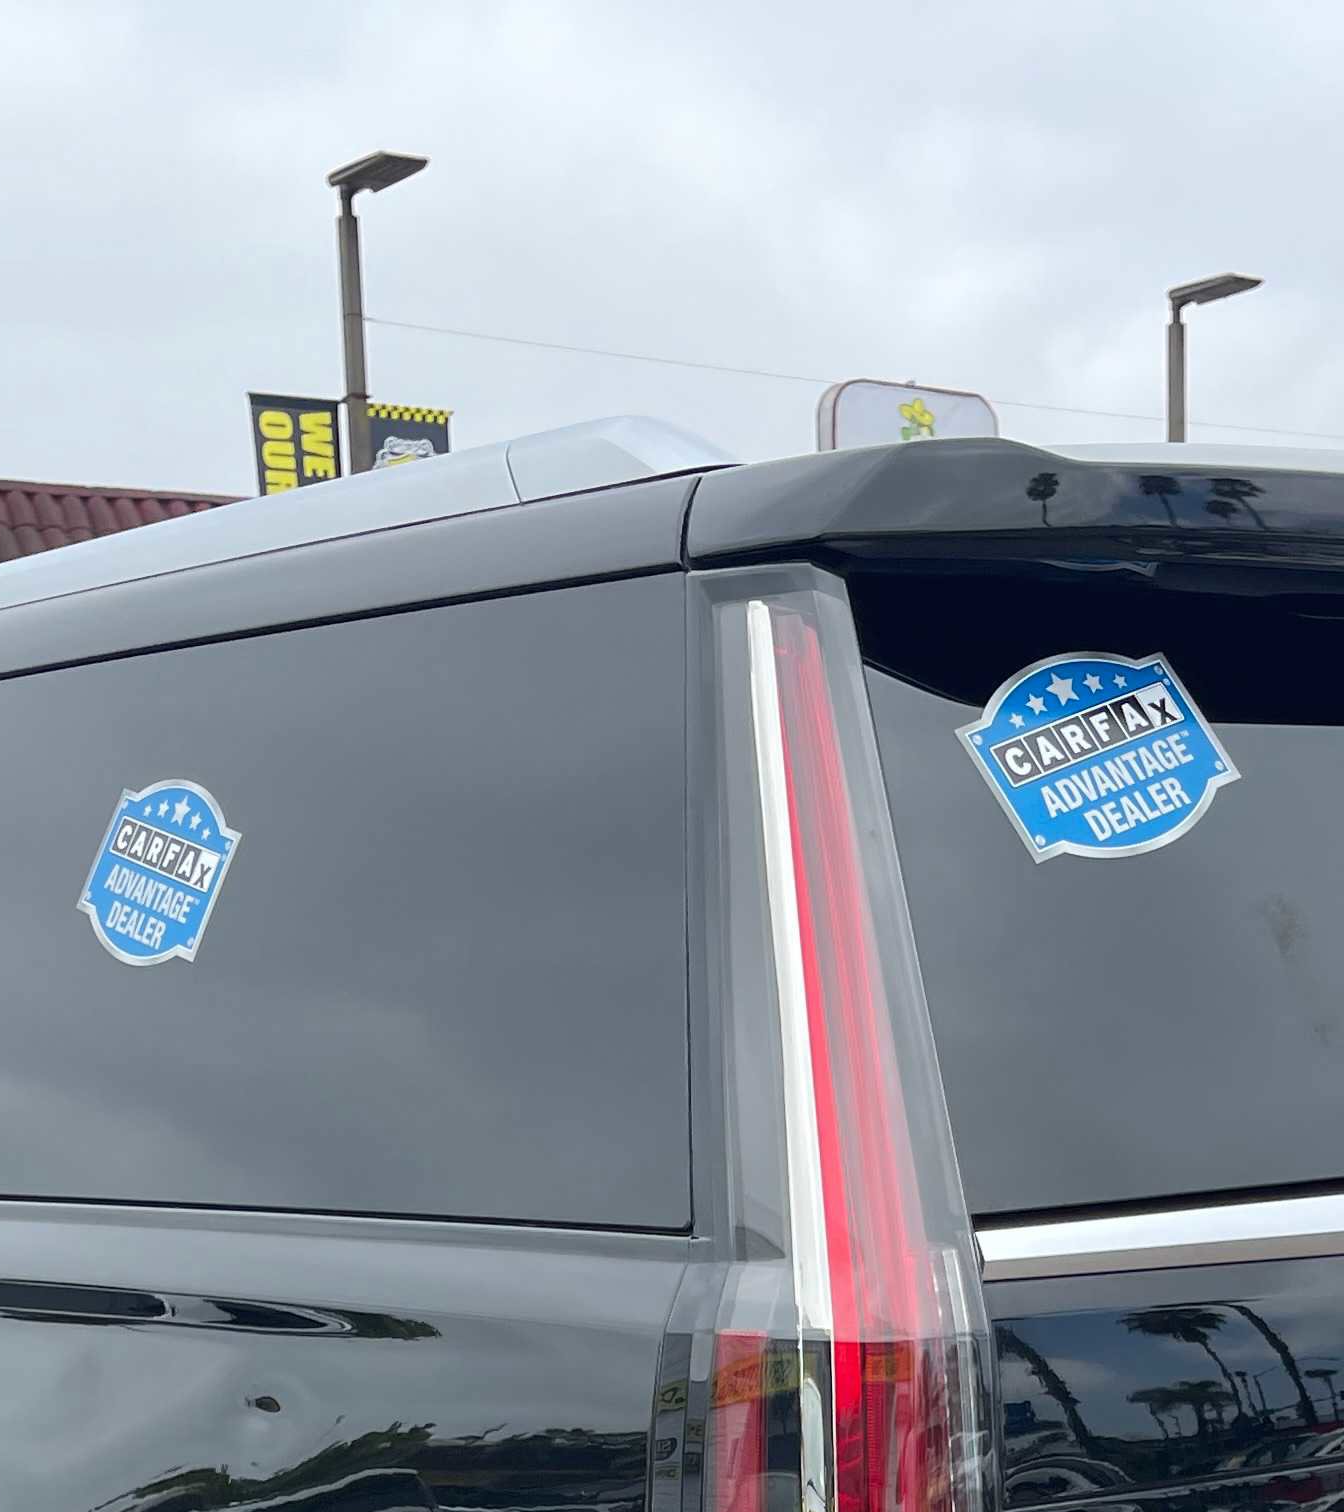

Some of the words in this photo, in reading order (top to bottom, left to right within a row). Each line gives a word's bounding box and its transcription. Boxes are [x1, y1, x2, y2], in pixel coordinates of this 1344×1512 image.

[299, 411, 337, 479] WE
[1002, 696, 1179, 778] CARFAX
[1082, 776, 1192, 843] DEALER
[115, 822, 218, 891] CARFAX
[105, 900, 167, 950] DEALER
